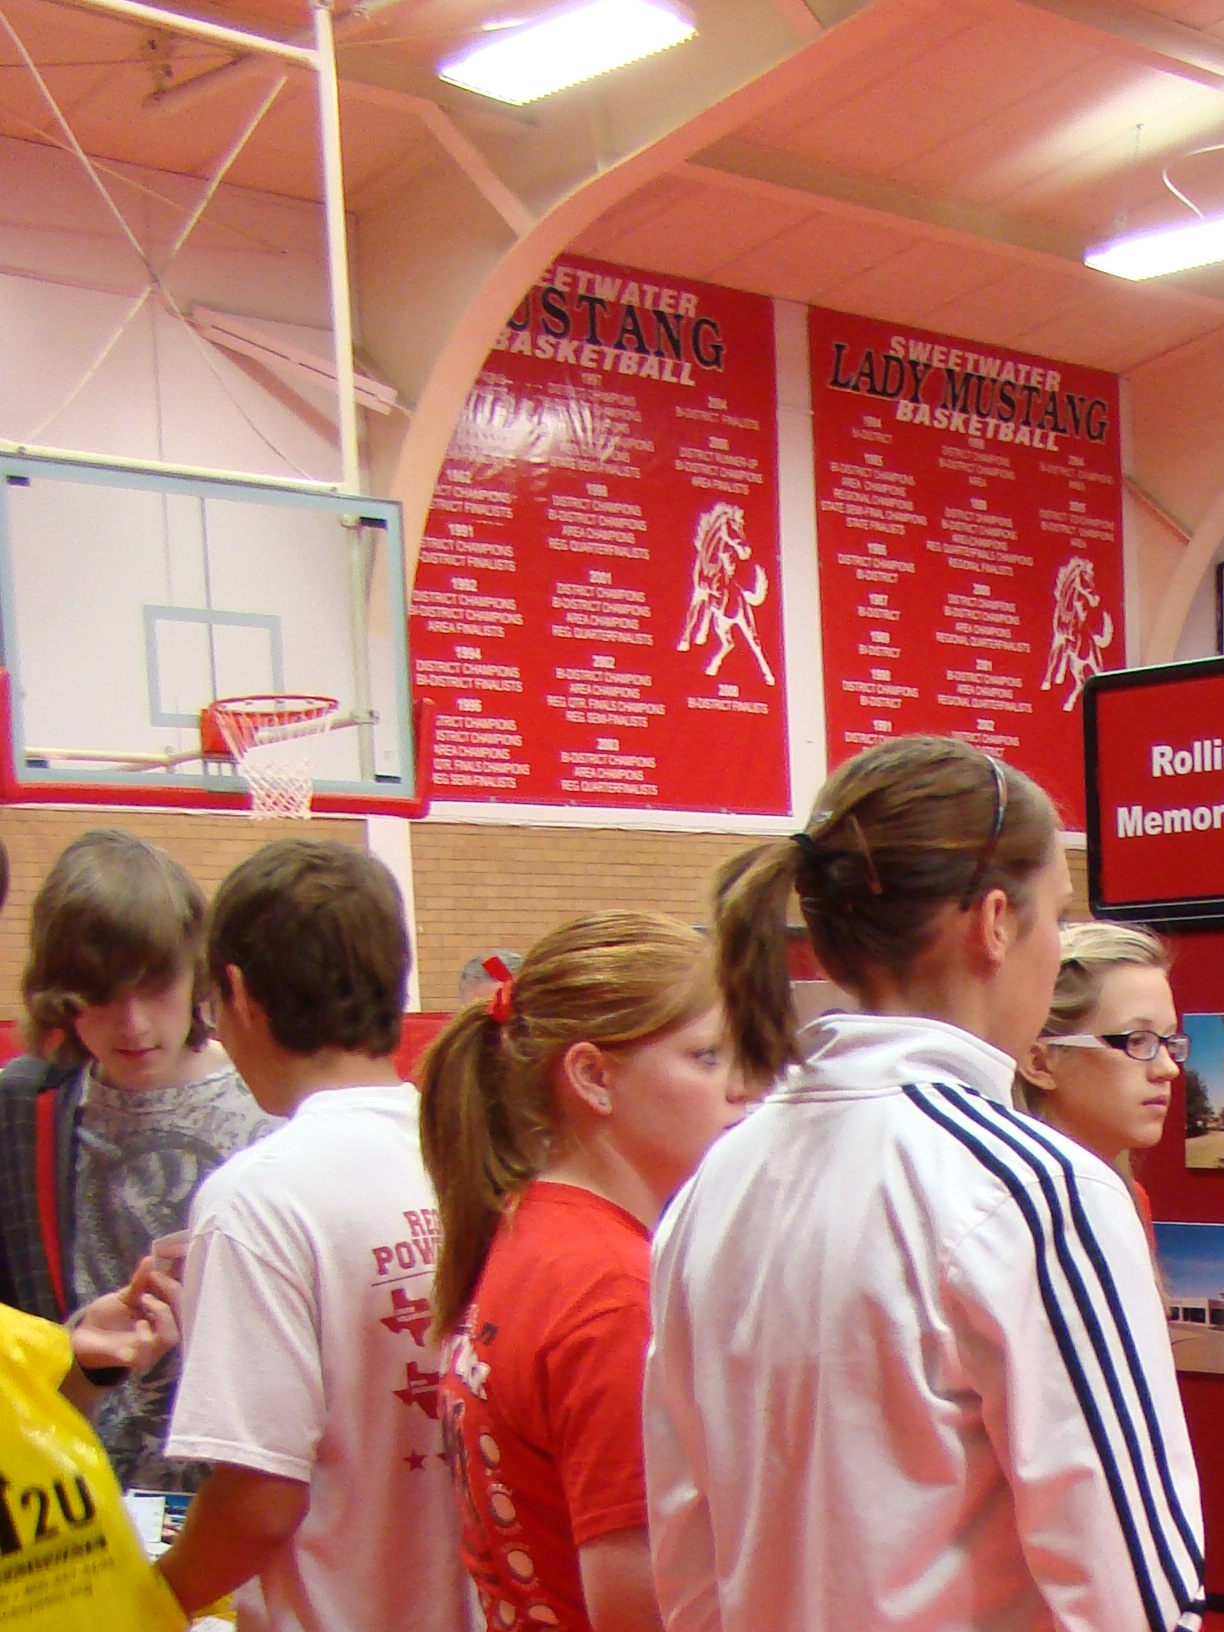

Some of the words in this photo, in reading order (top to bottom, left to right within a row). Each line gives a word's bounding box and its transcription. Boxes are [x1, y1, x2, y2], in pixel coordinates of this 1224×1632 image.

[492, 331, 696, 387] BASKETBALL
[889, 335, 1061, 392] SWEETWATER
[830, 342, 933, 405] LADY
[940, 367, 1109, 443] MUSTANG
[896, 399, 1060, 452] BASKETBALL
